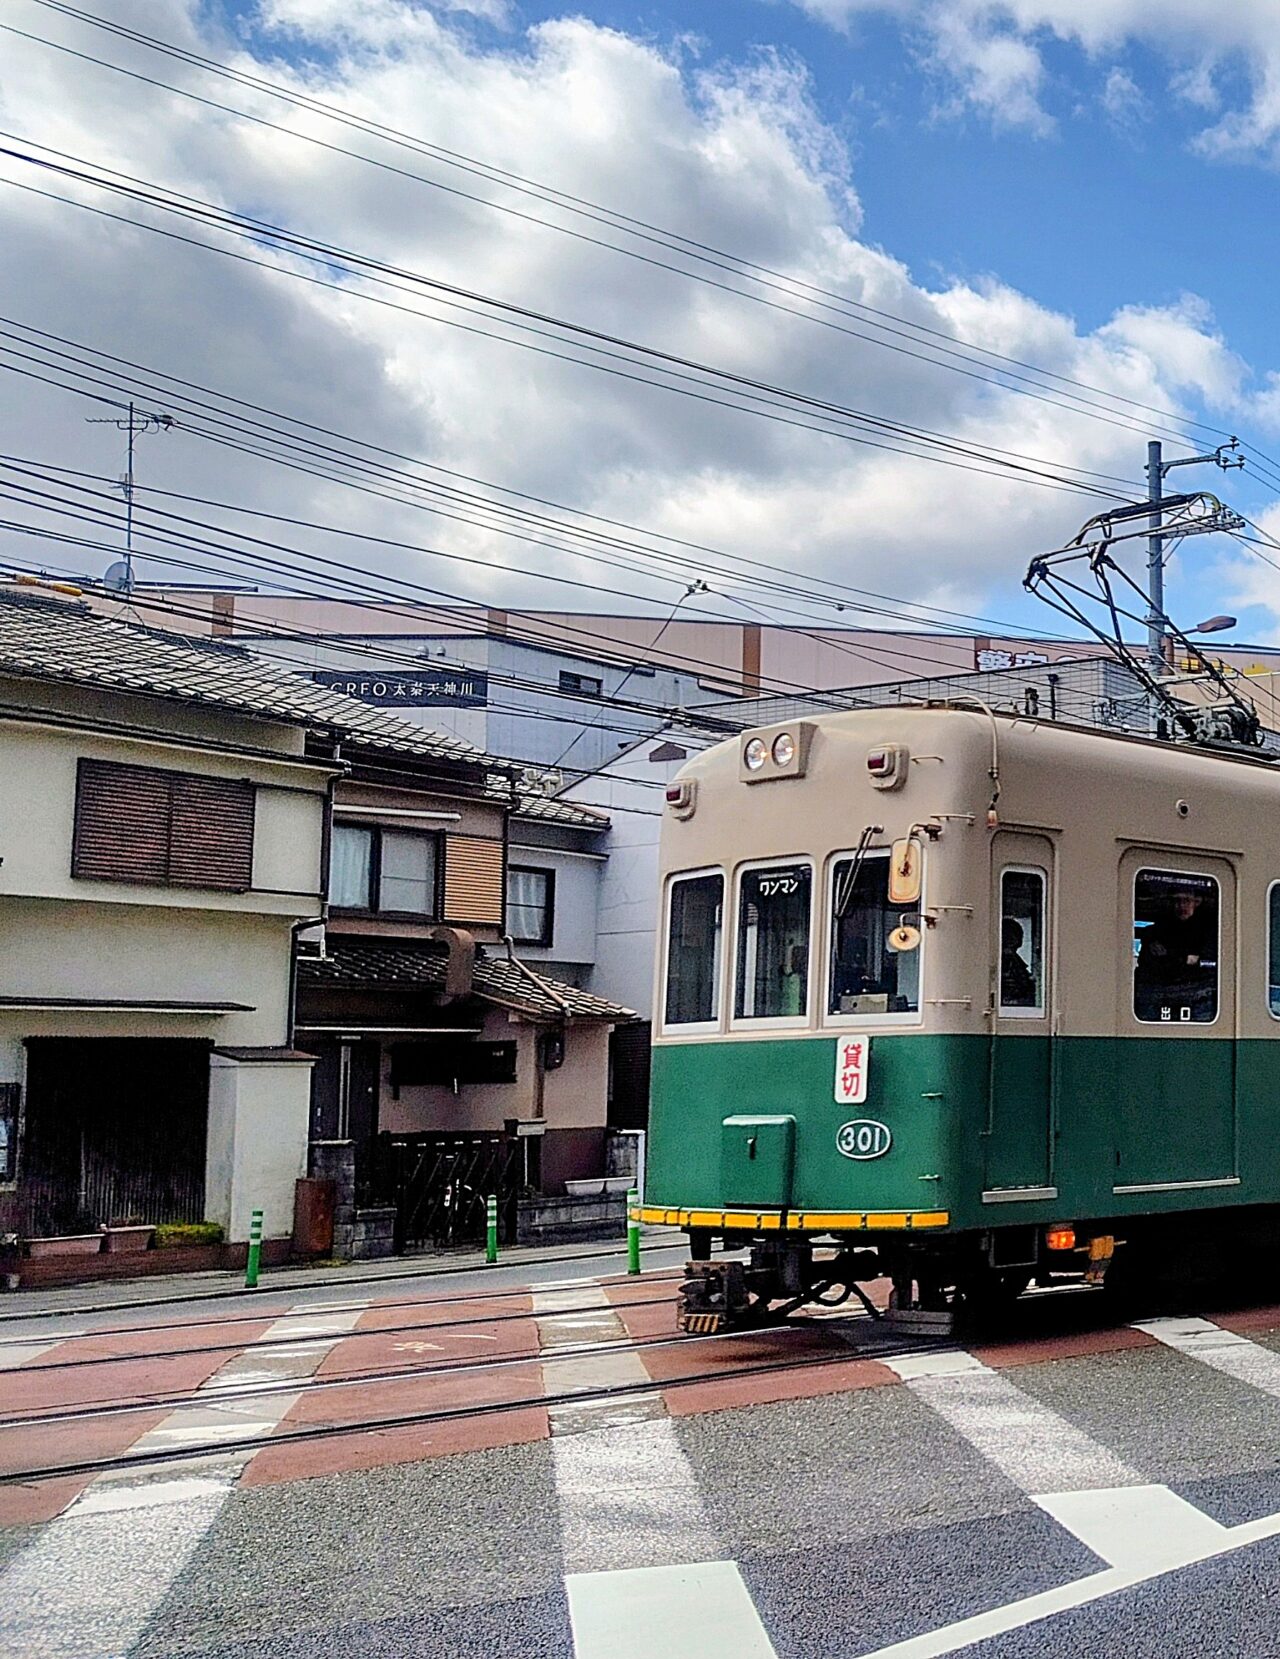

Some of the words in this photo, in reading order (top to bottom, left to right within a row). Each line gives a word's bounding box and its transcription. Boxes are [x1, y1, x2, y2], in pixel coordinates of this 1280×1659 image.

[759, 879, 798, 896] ワンマン
[1160, 1006, 1190, 1020] 出口
[841, 1043, 862, 1096] 貸切
[840, 1126, 880, 1152] 301
